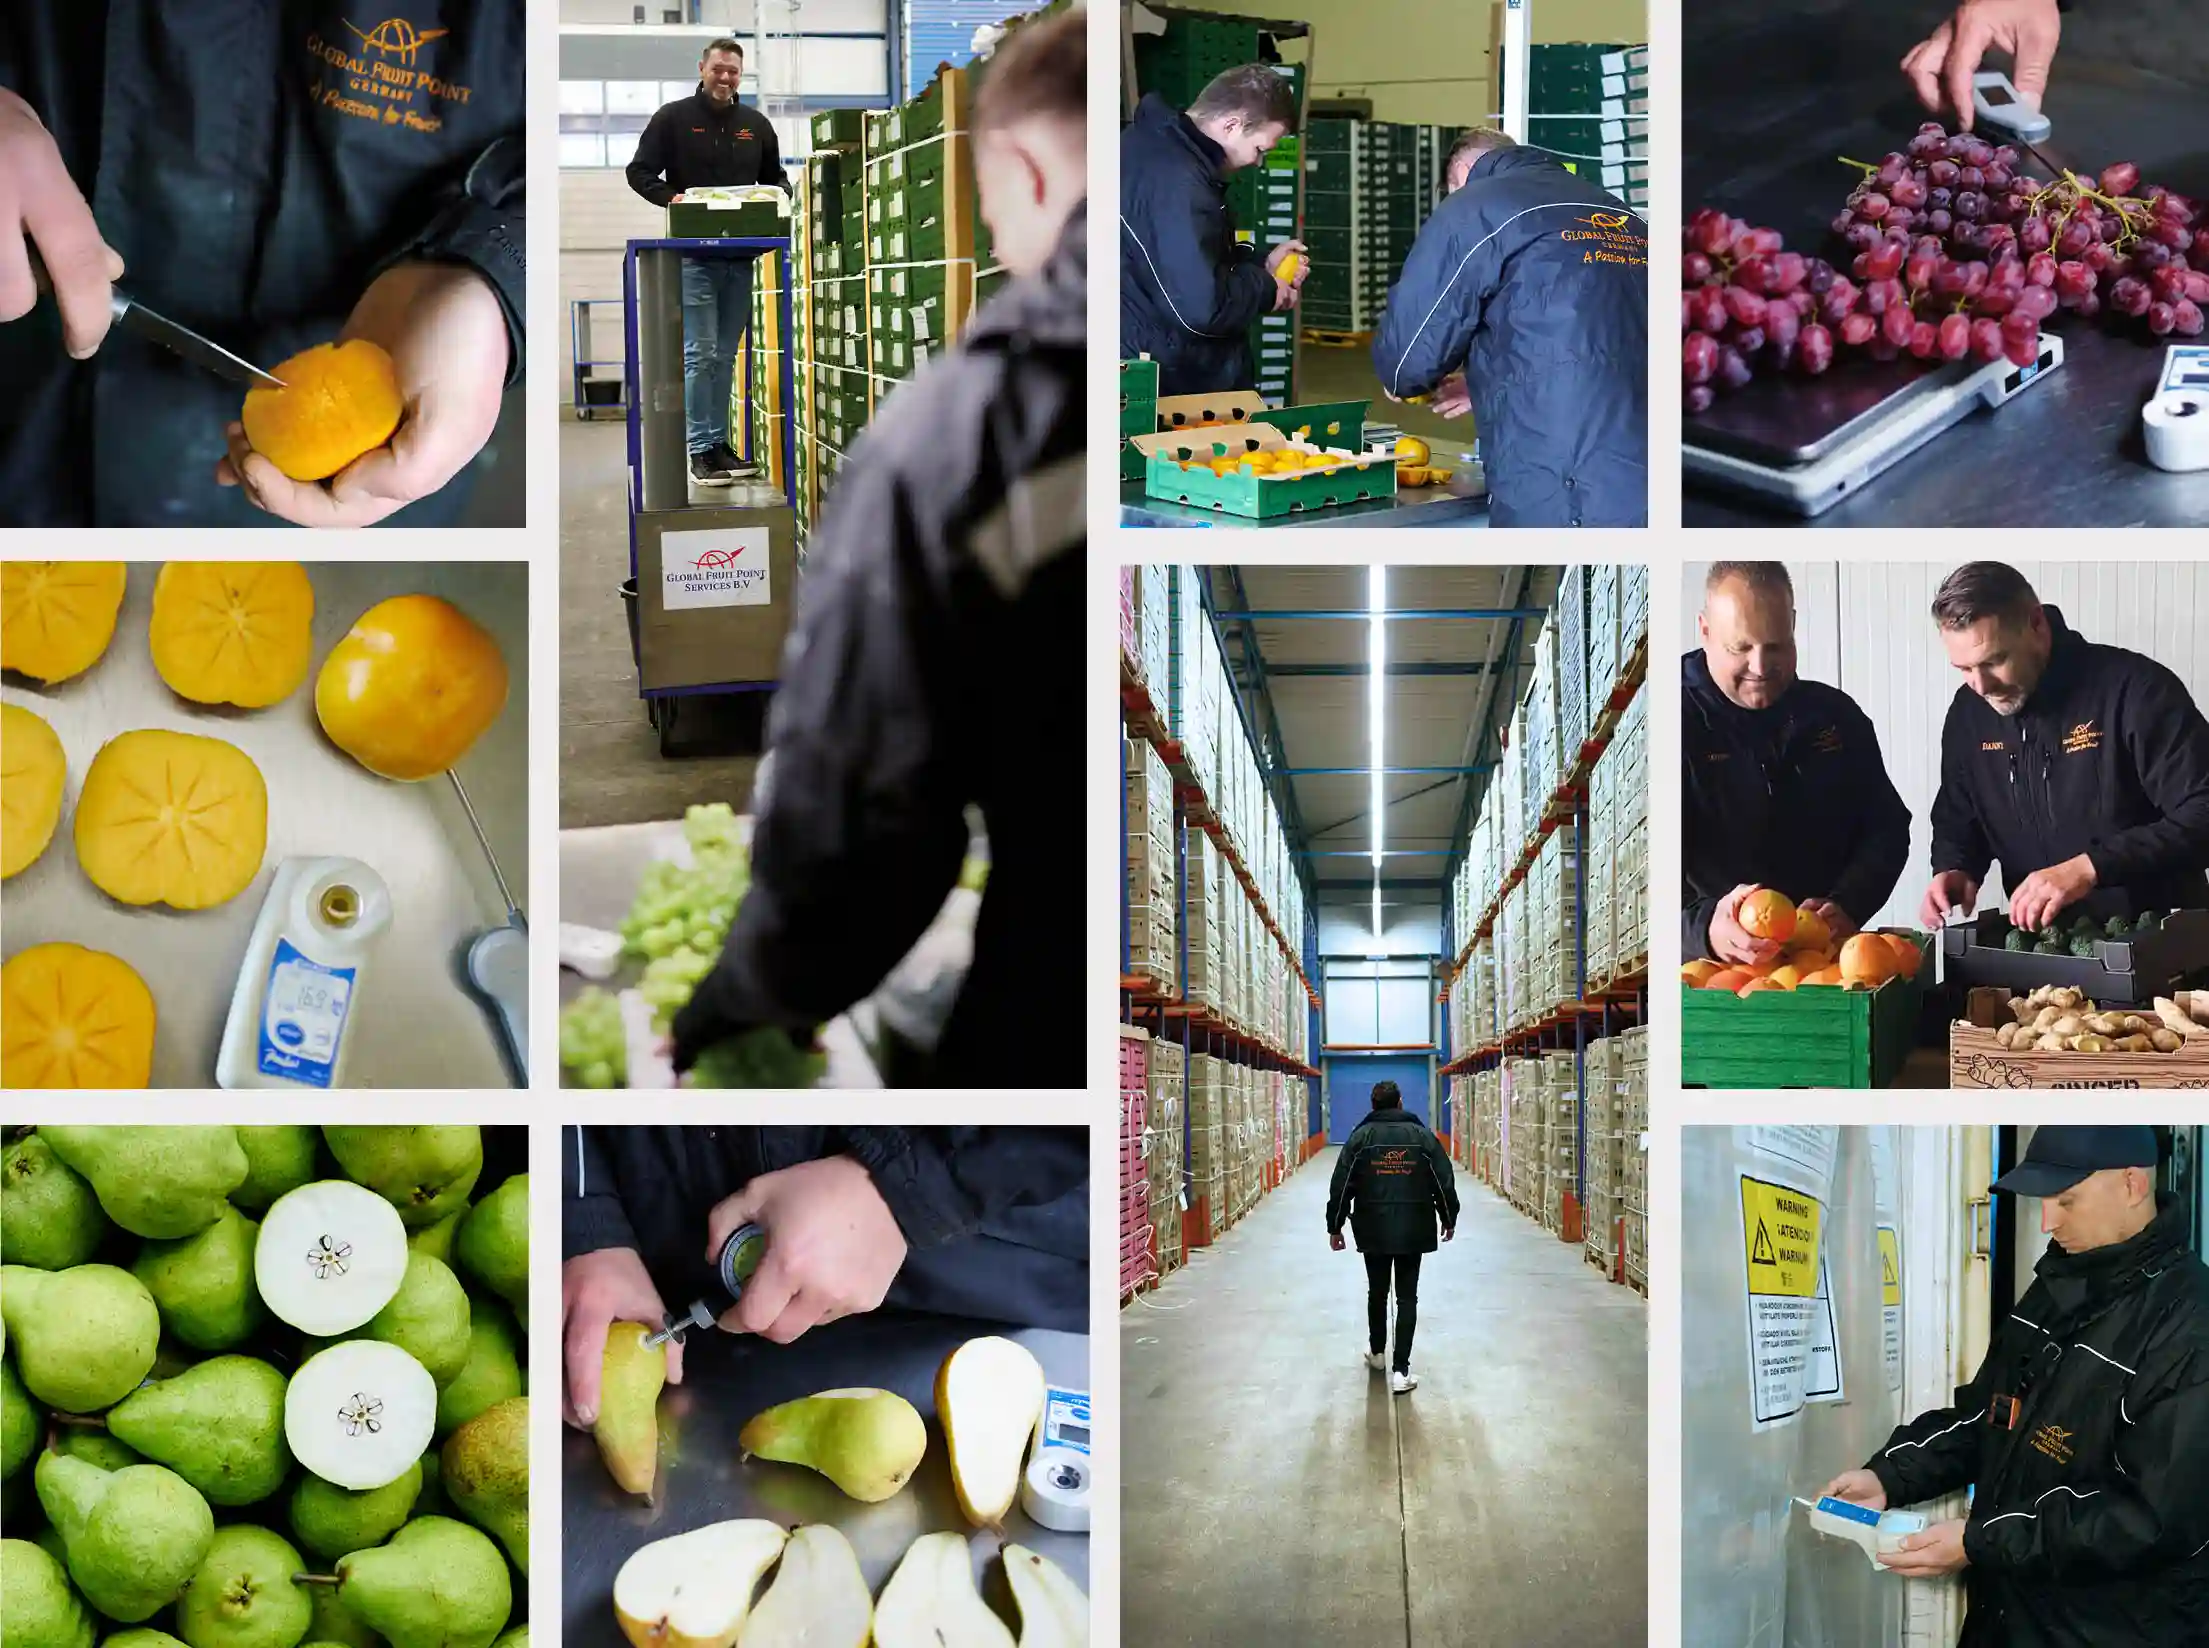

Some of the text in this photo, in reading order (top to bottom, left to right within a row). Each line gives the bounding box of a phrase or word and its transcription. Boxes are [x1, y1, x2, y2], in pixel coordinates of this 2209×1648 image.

[307, 35, 472, 105] GLOBAL FRUIT POINT
[1562, 230, 1605, 241] GLOBAL
[1584, 250, 1592, 263] A
[666, 569, 766, 582] GLOBAL FRUIT POINT
[685, 582, 731, 592] SERVICES
[1776, 1197, 1808, 1218] WARNING
